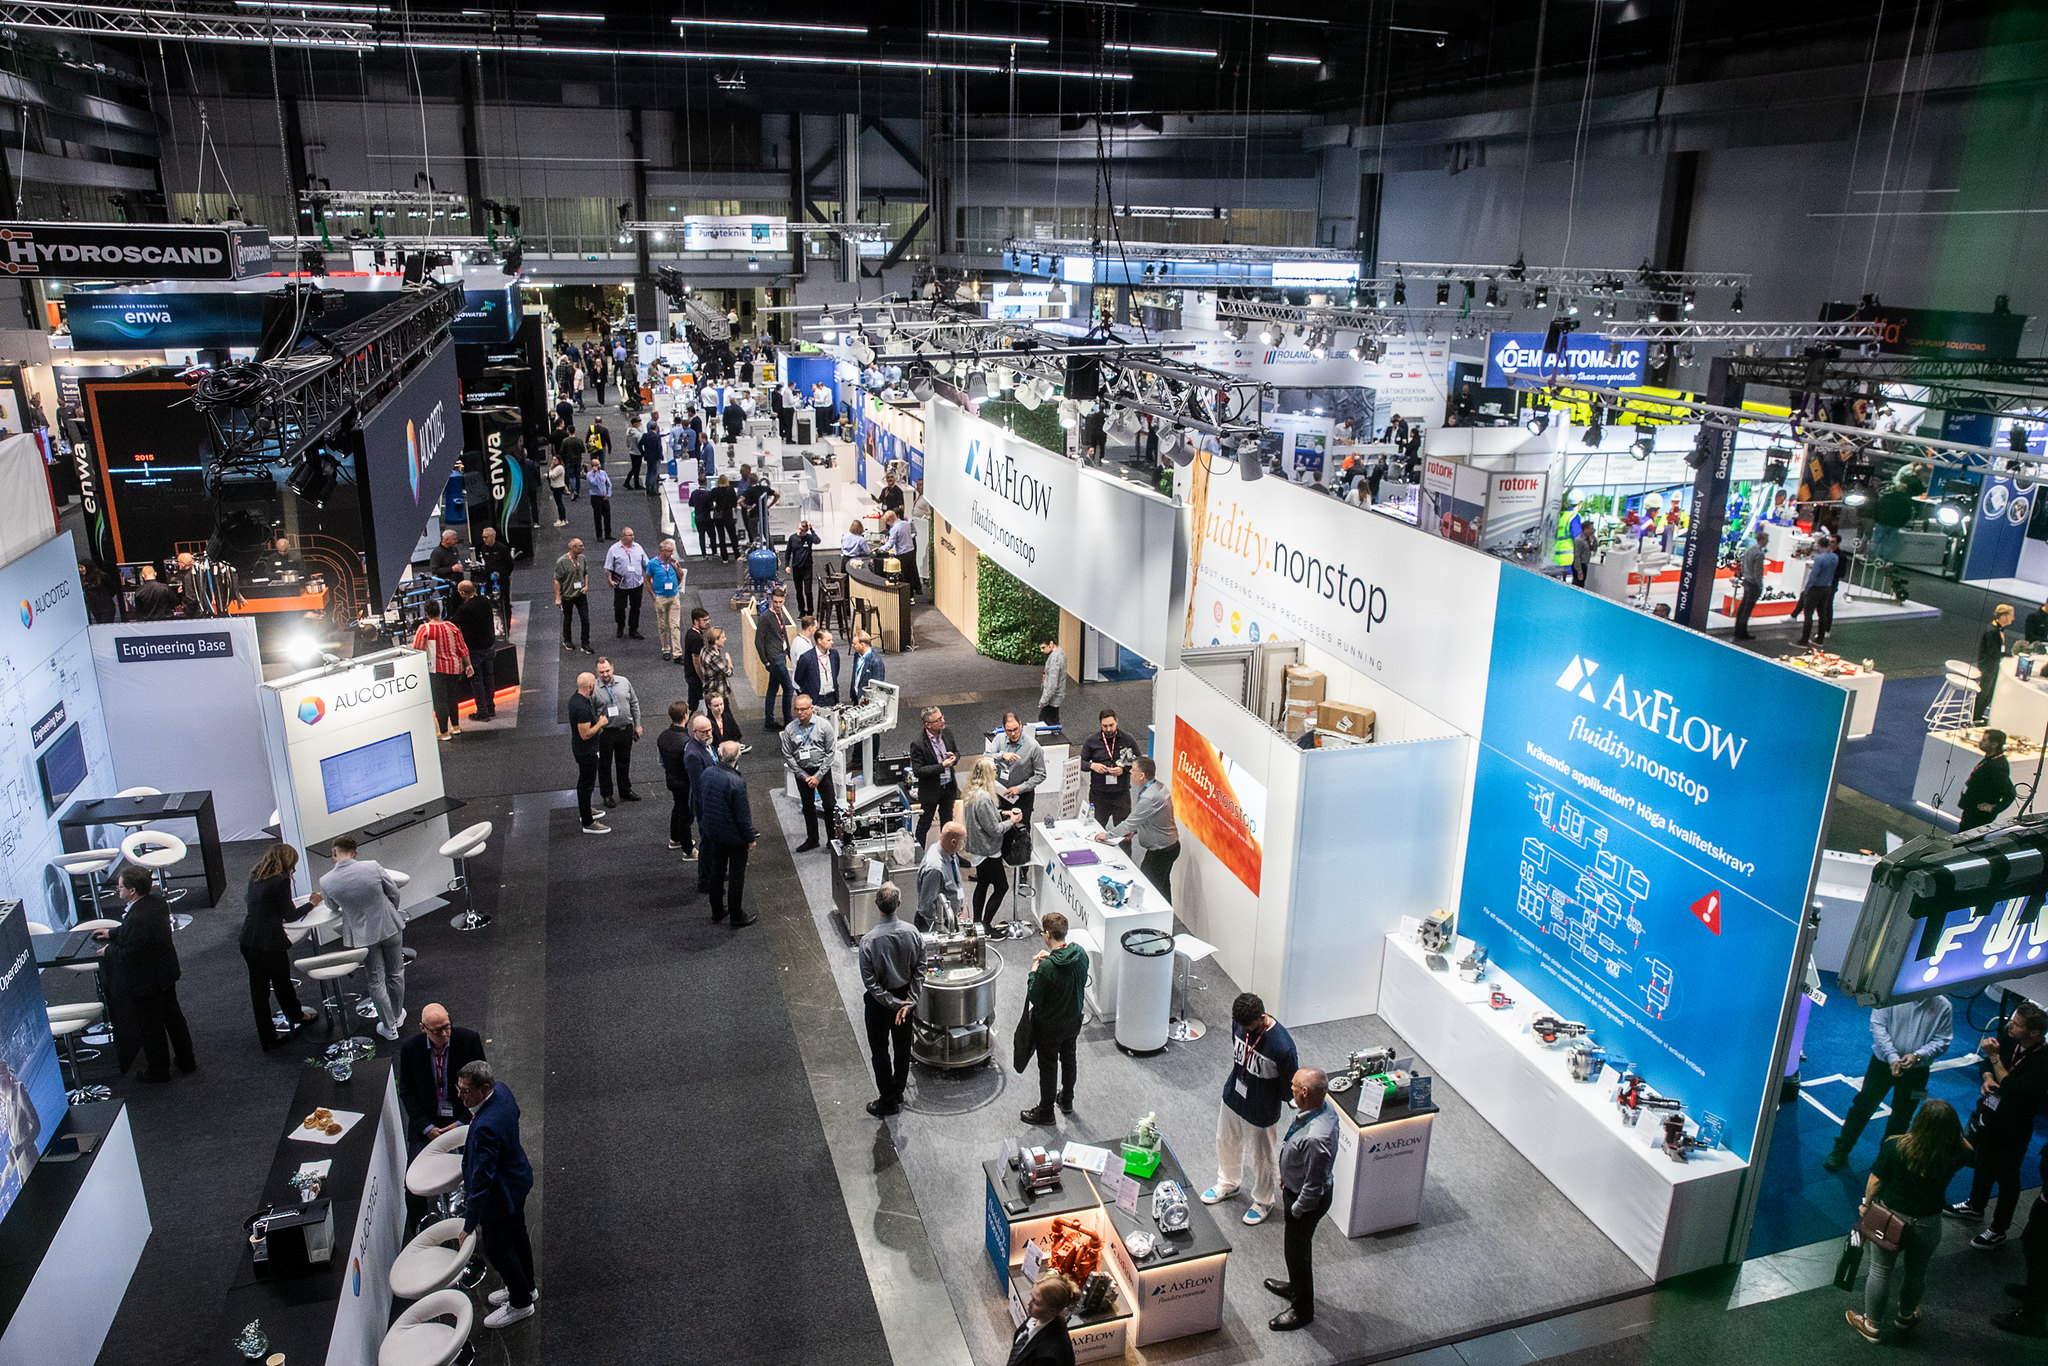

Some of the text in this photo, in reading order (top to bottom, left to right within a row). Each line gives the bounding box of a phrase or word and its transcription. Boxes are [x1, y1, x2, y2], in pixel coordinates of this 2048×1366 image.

[698, 230, 747, 239] Pumteknik
[7, 240, 223, 264] HYDROSCAND
[238, 244, 271, 266] HYDROSCAND
[124, 311, 172, 324] enwa
[1277, 350, 1311, 359] ROLAND
[1503, 350, 1541, 368] OEM
[1945, 341, 1986, 351] SOLUTIONS
[466, 391, 506, 399] ENVIROWATER
[419, 400, 446, 474] AUCOTEC
[74, 442, 97, 514] enwa
[487, 431, 506, 500] enwa
[1427, 461, 1453, 479] rotork
[1499, 477, 1539, 491] rotork
[1690, 501, 1702, 535] perfect
[970, 512, 1036, 568] fluidity.nonstop
[1685, 538, 1696, 570] flow.
[1684, 572, 1693, 588] For
[35, 580, 70, 616] AUCOTEC
[1679, 590, 1688, 612] you.
[1200, 565, 1384, 671] BOUT KEEPING YOUR PROCESSES RUNNING
[122, 639, 226, 658] Engineering Base
[334, 673, 419, 711] AUCOTEC
[33, 707, 65, 743] Engineering Base
[1568, 715, 1709, 805] fluidity.nonstop
[1177, 750, 1257, 834] fluidity.nonstop
[1526, 740, 1756, 877] Krävande applikation? Höga kvalitetskrav?
[0, 948, 30, 992] Operation
[1158, 1289, 1206, 1304] fluidity.nonstop
